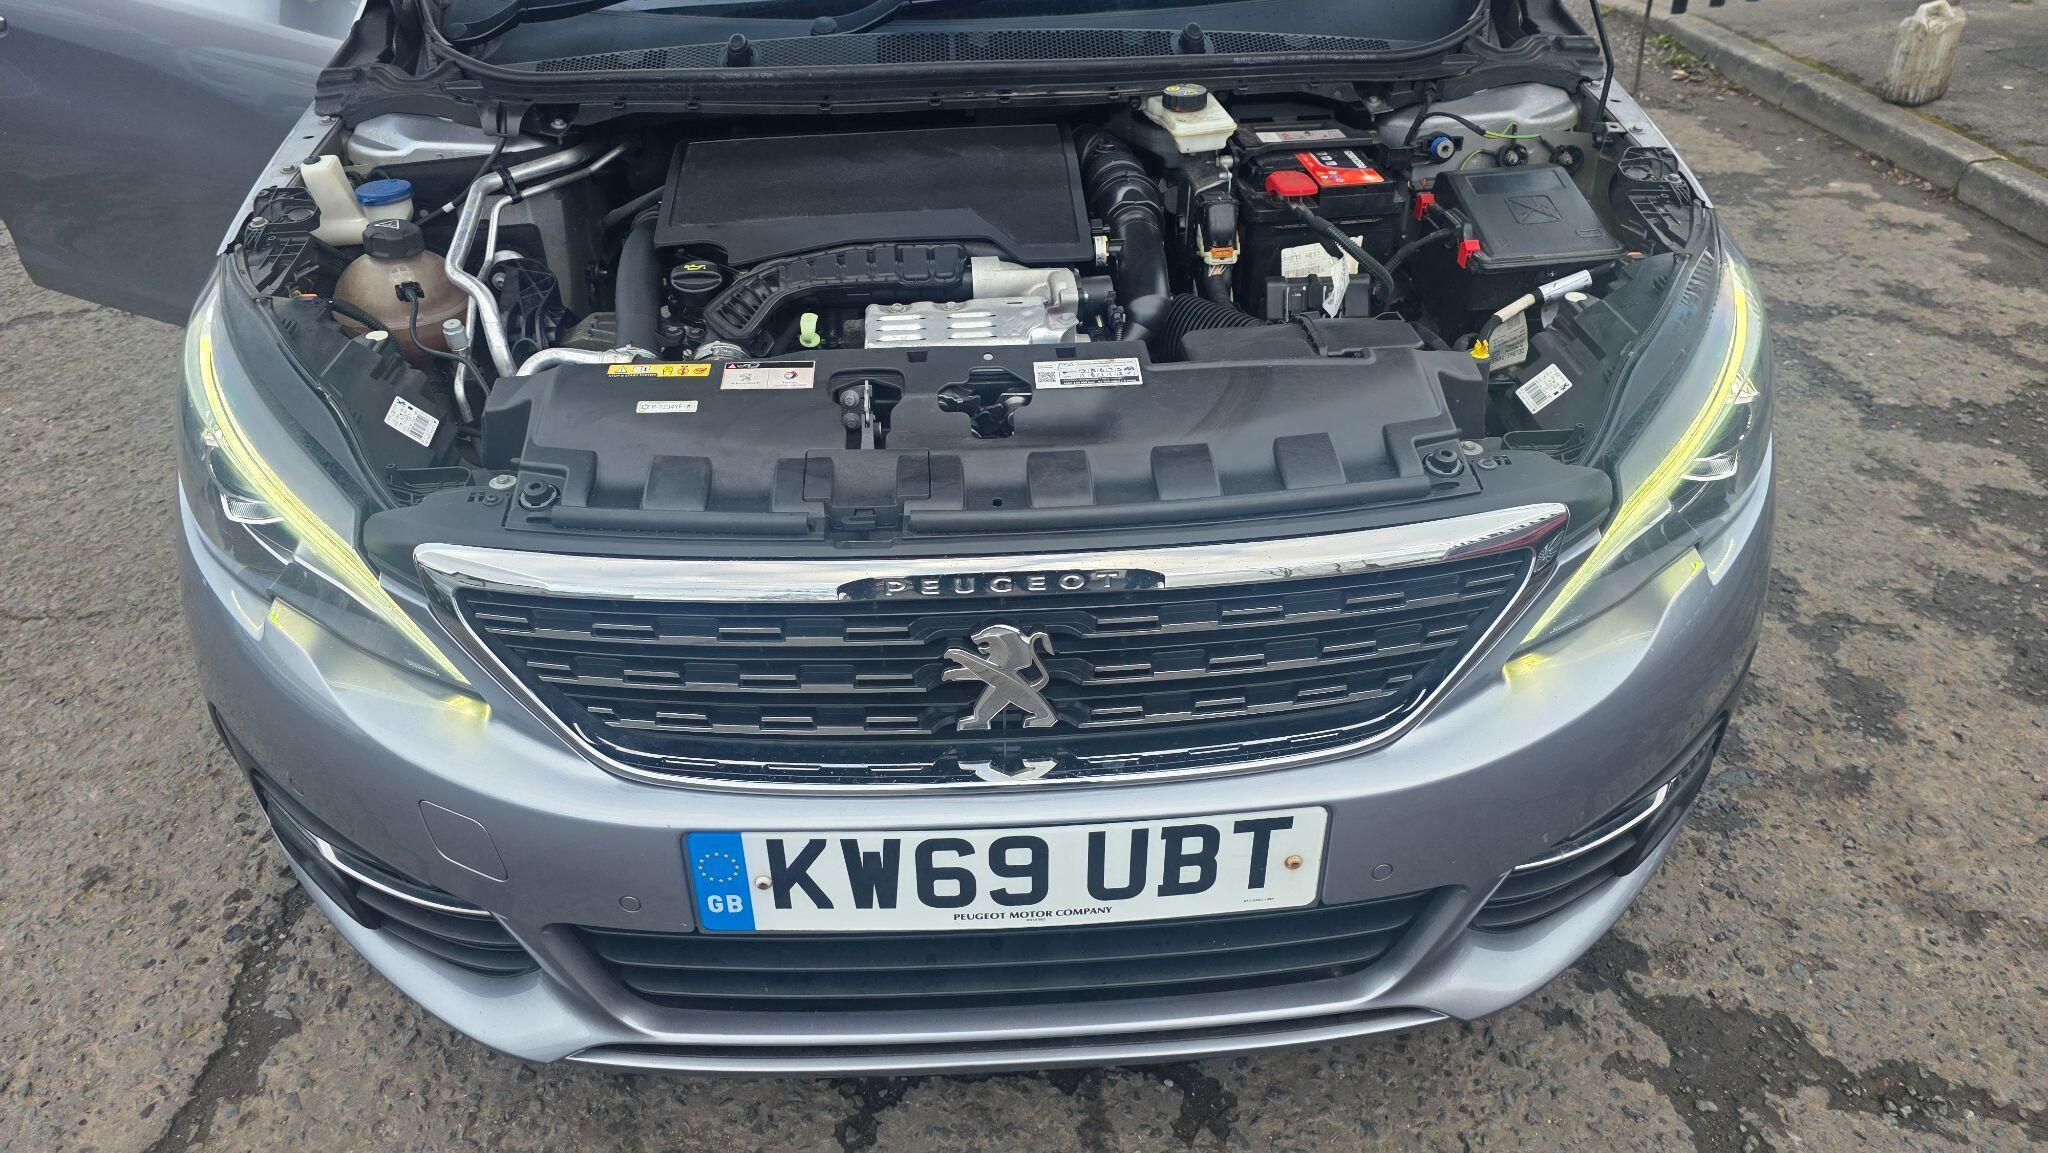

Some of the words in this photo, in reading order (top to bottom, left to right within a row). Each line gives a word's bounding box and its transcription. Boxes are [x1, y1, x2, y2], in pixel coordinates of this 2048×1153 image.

[884, 571, 1119, 597] PEUGEOT
[766, 835, 1050, 909] KW69
[1087, 816, 1294, 901] UBT
[707, 894, 744, 913] GB
[953, 912, 1007, 921] PEUGEOT
[1009, 910, 1053, 919] MOTOR
[1056, 906, 1113, 917] COMPANY
